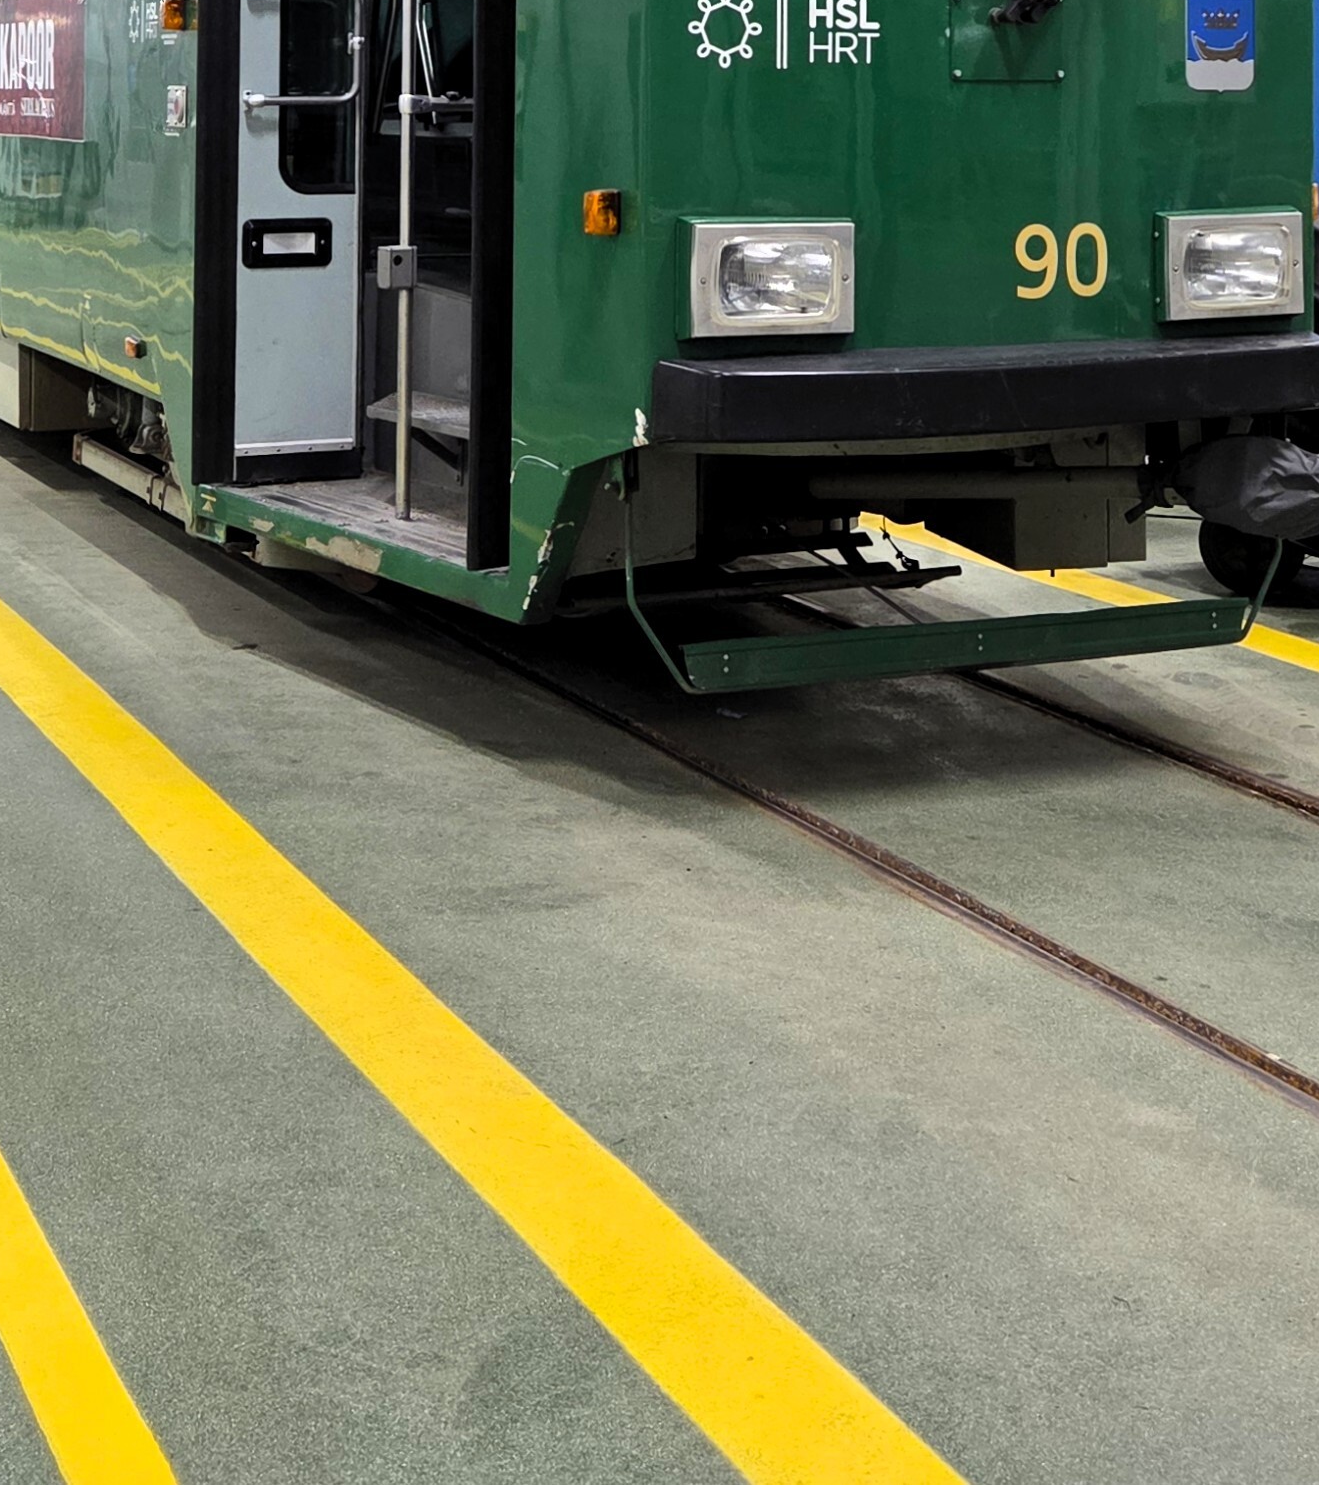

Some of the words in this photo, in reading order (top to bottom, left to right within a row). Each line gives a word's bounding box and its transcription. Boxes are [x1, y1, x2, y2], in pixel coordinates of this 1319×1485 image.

[0, 19, 55, 90] KAPOOR
[809, 31, 880, 64] HRT
[1015, 222, 1108, 299] 90
